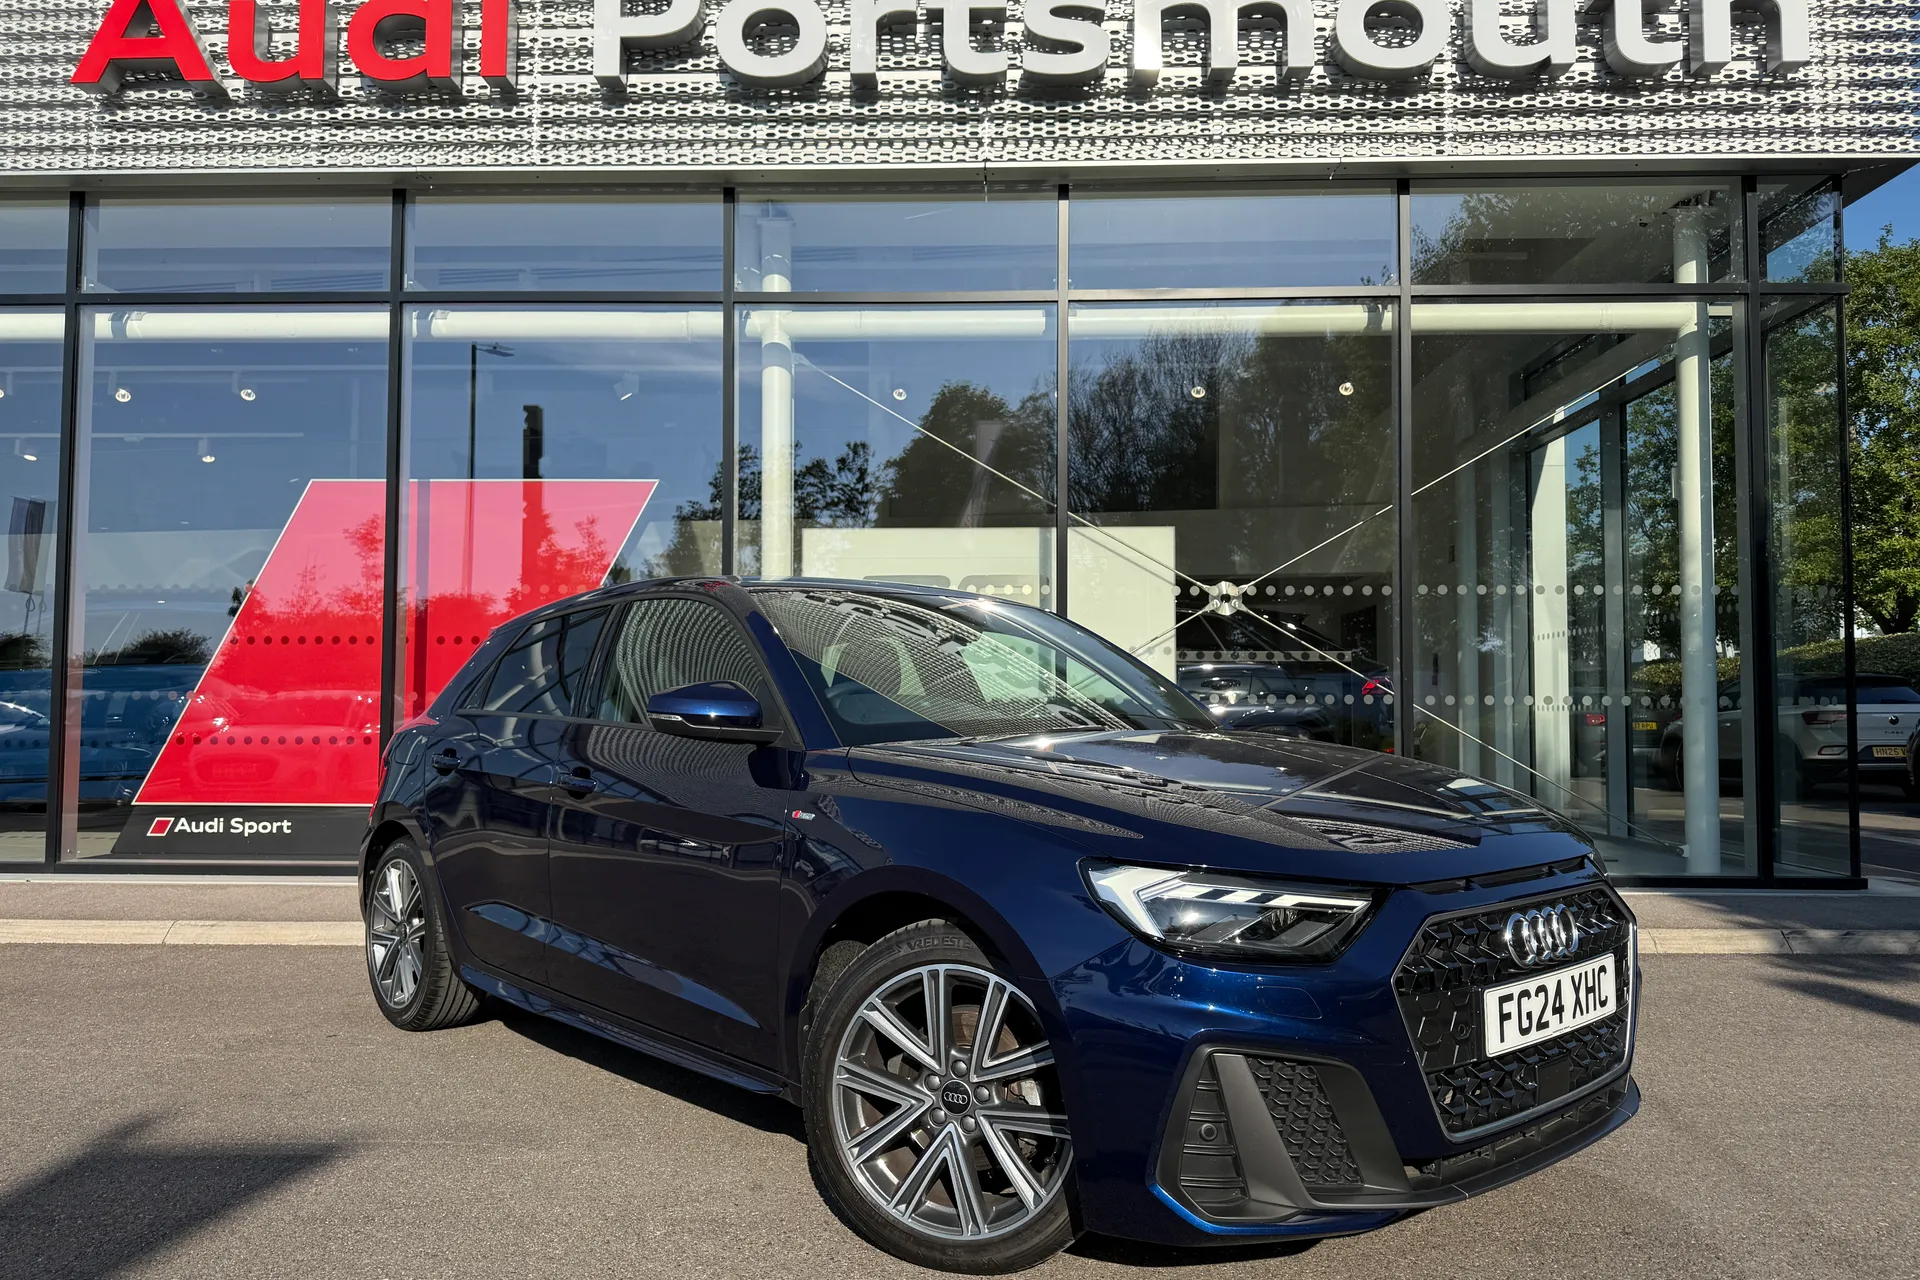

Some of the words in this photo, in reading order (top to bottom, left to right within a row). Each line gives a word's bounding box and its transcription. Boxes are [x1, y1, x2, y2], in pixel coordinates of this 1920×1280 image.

[70, 0, 515, 88] Audi
[593, 0, 1809, 80] Portsmouth
[1875, 747, 1900, 756] HN25
[174, 817, 224, 833] Audi
[230, 817, 292, 837] Sport
[1498, 979, 1565, 1044] FG24
[1570, 964, 1609, 1020] XHC
